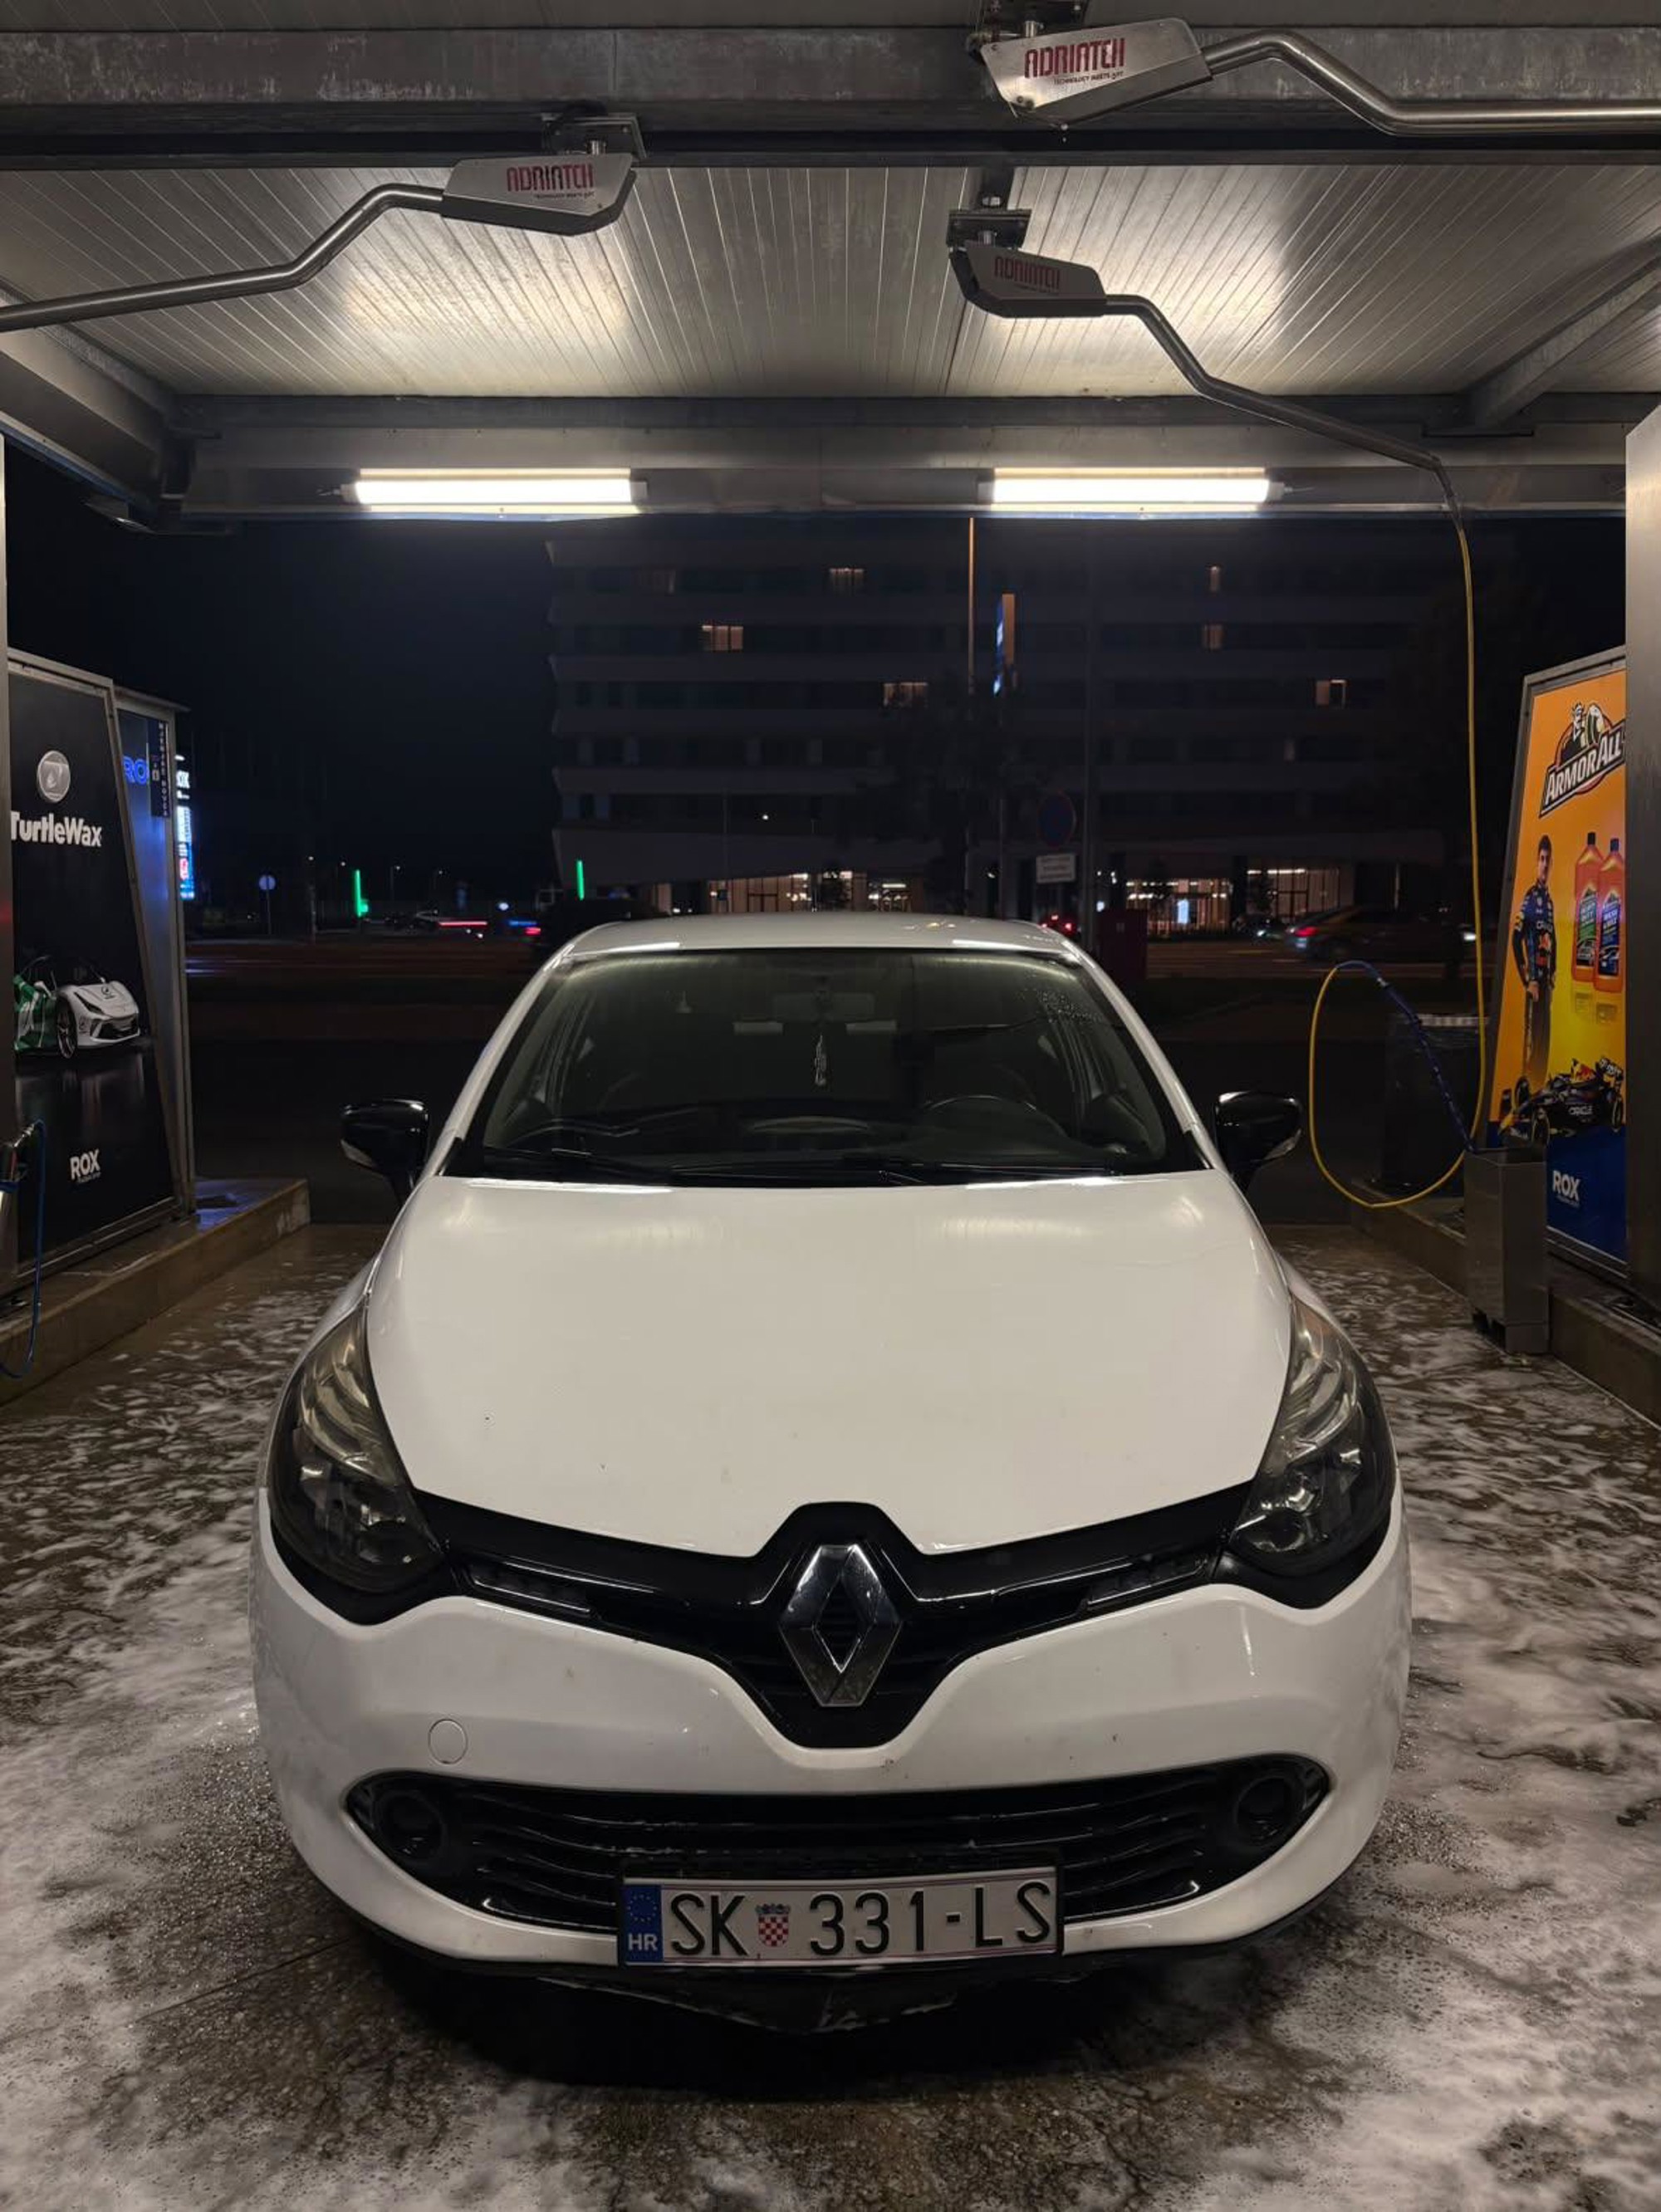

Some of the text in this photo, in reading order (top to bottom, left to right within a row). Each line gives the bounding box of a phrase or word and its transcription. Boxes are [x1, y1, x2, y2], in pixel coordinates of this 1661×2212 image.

[69, 1148, 101, 1181] ROX
[1551, 1169, 1582, 1202] ROX
[670, 1880, 1051, 1956] SK 331-LS
[627, 1933, 659, 1952] HR
